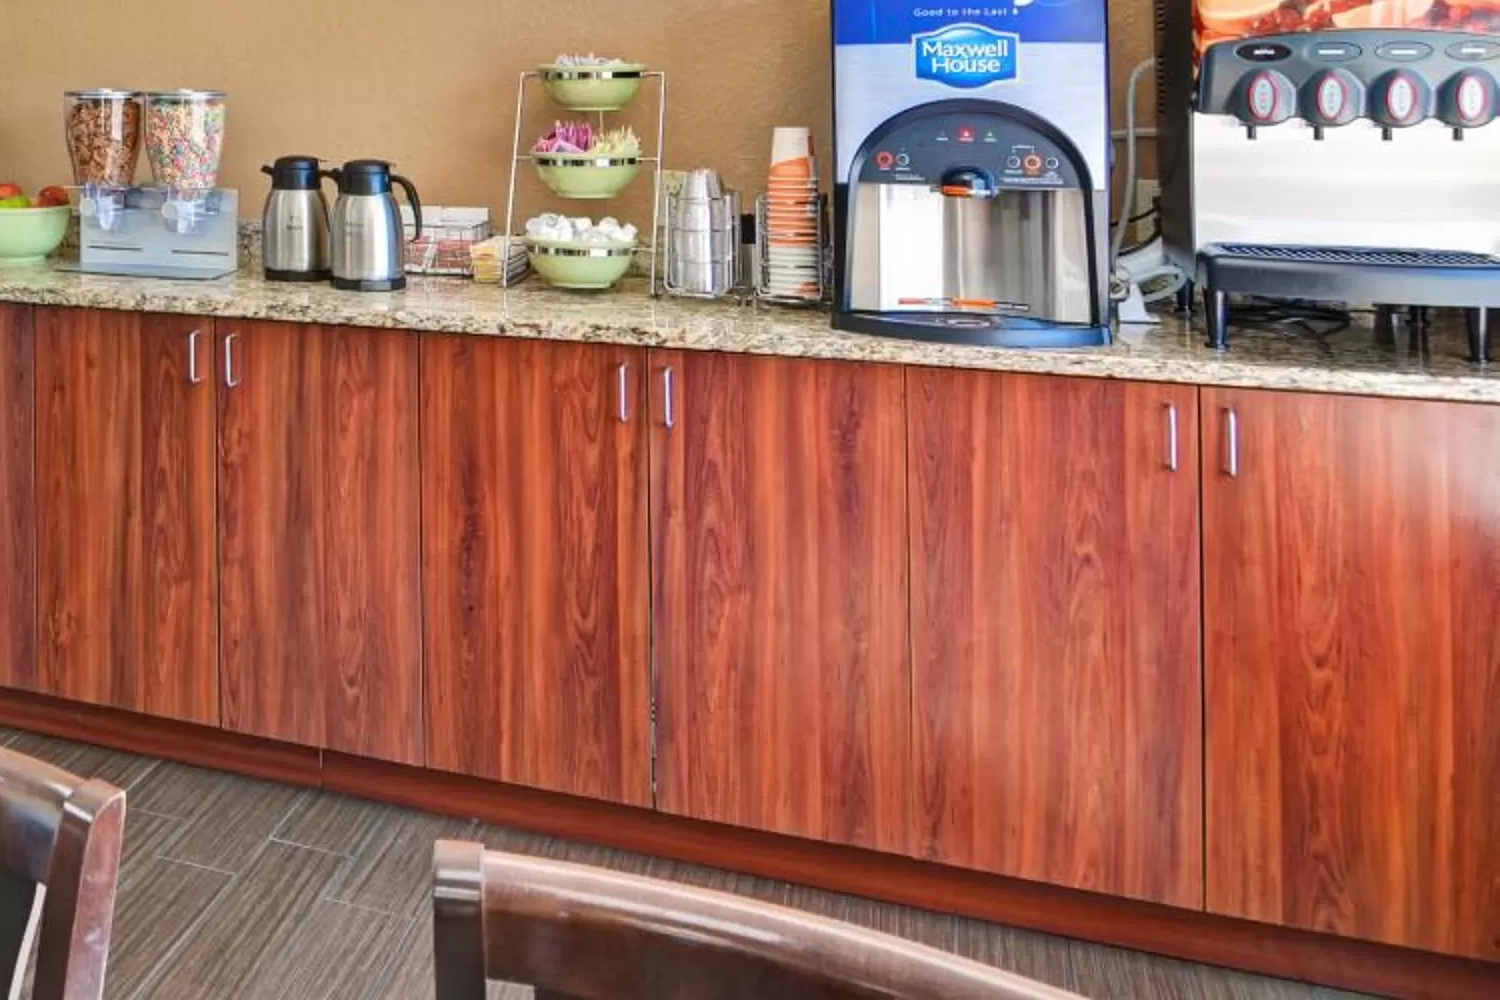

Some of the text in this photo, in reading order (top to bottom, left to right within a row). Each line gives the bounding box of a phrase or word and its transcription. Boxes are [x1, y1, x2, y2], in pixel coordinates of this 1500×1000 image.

[913, 7, 1007, 17] Good to the Last
[922, 39, 1009, 58] Maxwell
[931, 57, 1001, 74] House
